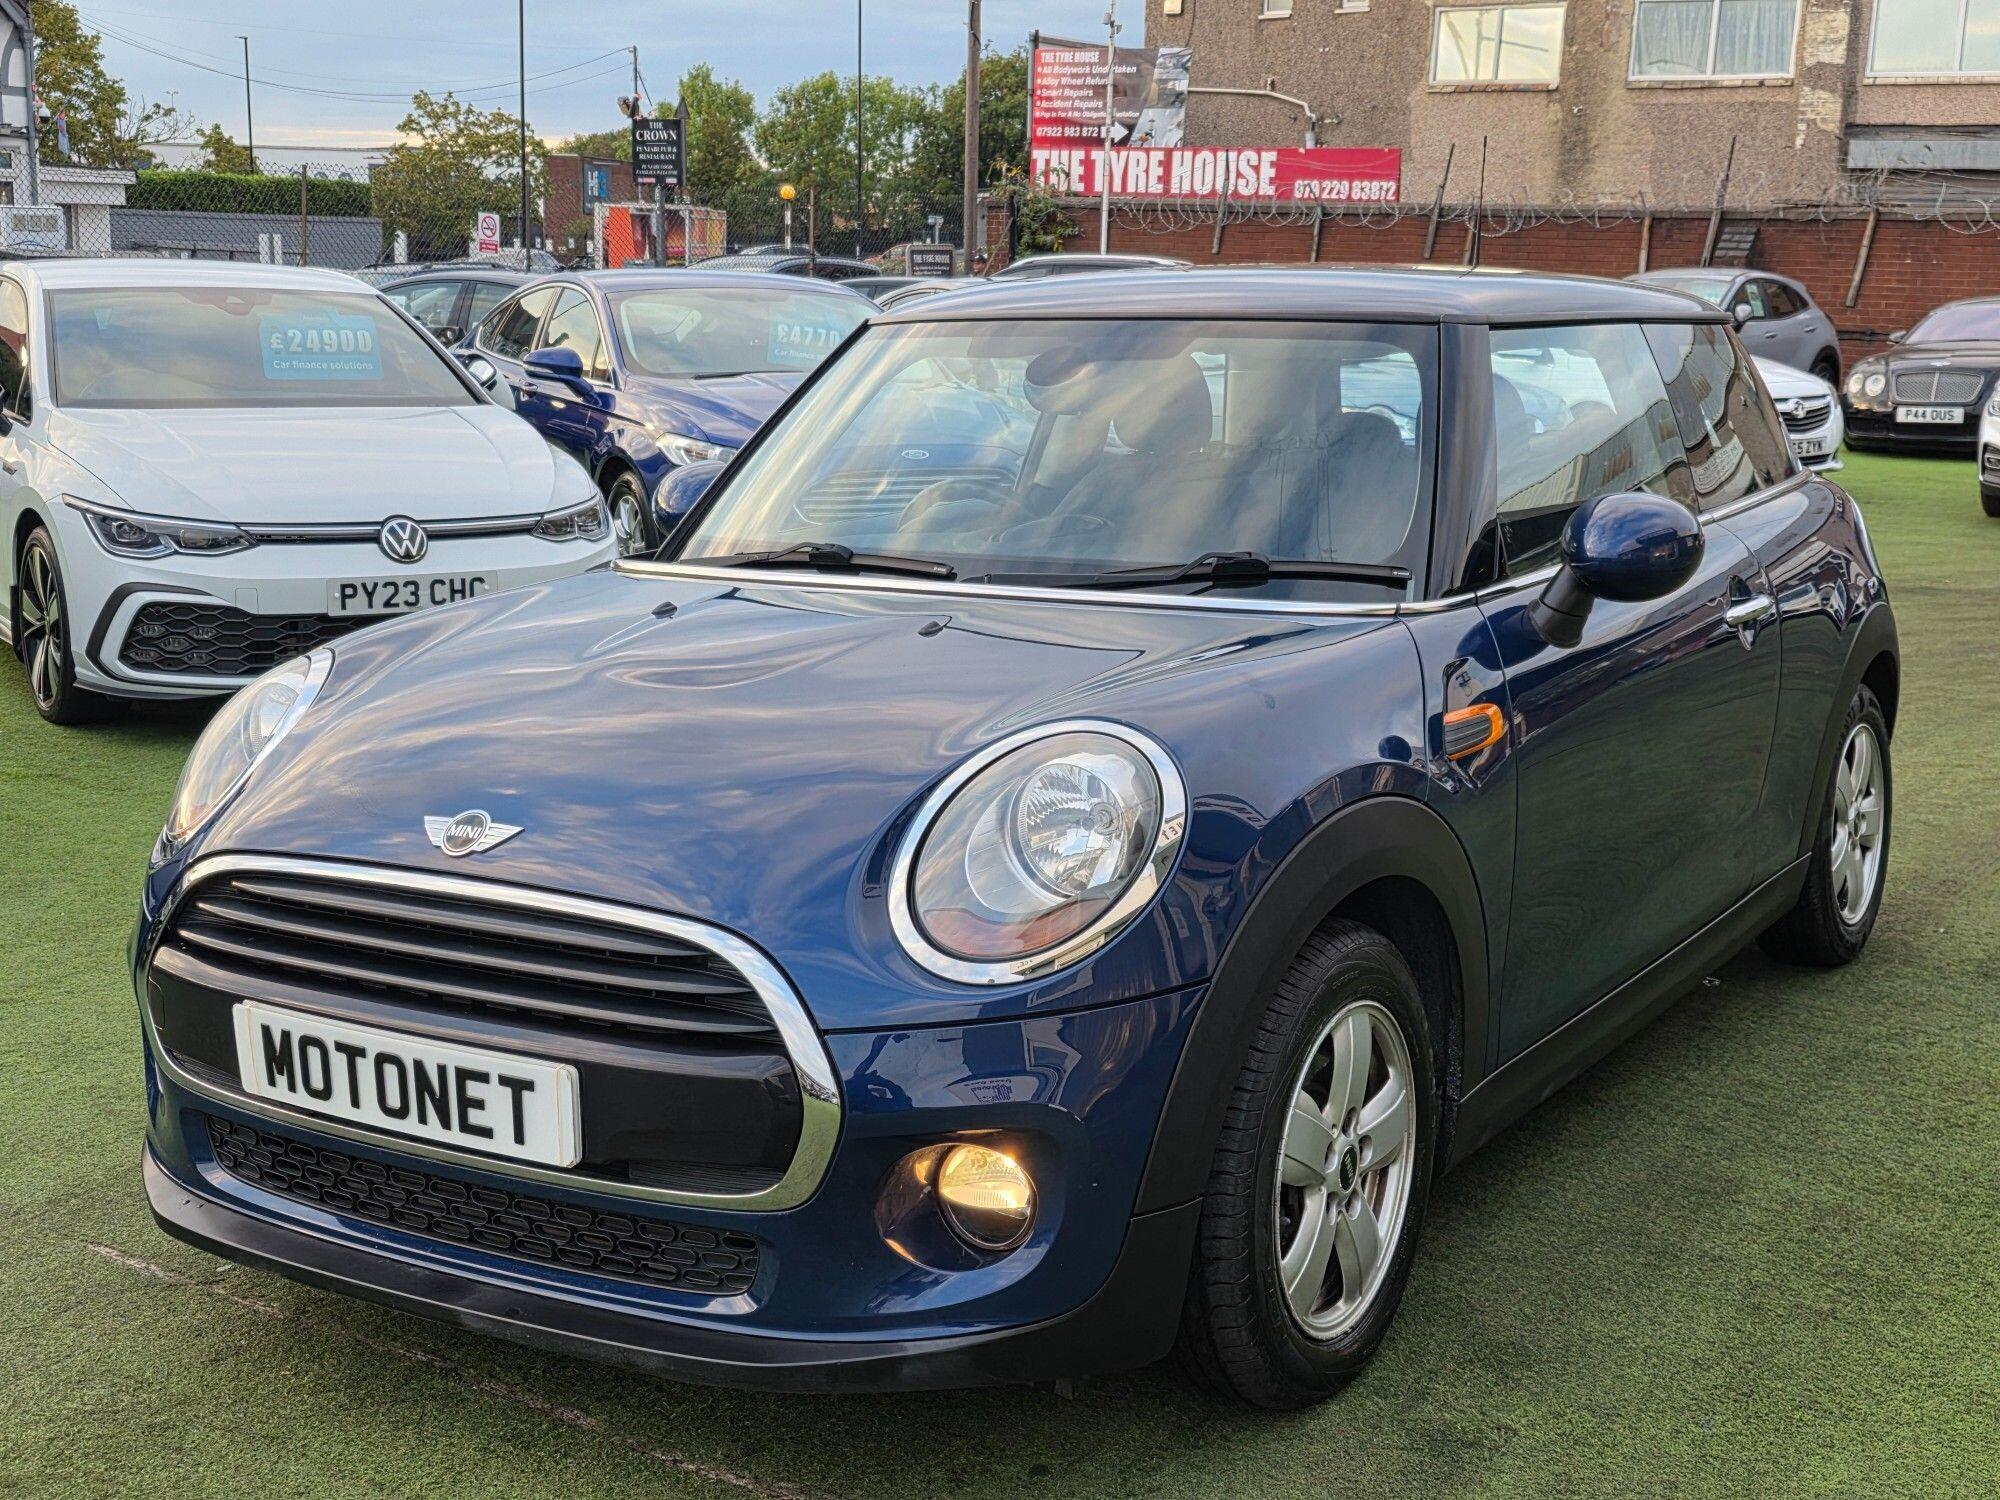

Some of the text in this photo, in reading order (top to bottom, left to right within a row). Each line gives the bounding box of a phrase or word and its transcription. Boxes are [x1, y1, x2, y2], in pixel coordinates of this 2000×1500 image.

[1041, 52, 1099, 62] THE TYRE HOUSE
[1053, 65, 1090, 76] Bodywork
[1092, 64, 1137, 74] Undrtaken
[1041, 78, 1060, 87] Alloy
[1061, 77, 1083, 85] Wheel
[1041, 89, 1094, 98] Smart Repairs
[1073, 100, 1103, 109] Repairs
[649, 121, 664, 129] THE
[635, 130, 677, 140] CROWN
[1036, 127, 1099, 137] 07922 983 872
[1032, 149, 1278, 196] THE TYRE HOUSE
[1321, 180, 1349, 199] 229
[270, 329, 373, 352] £24900
[775, 347, 788, 356] Car
[273, 359, 373, 370] Car finance solutions
[339, 579, 421, 611] PY23
[447, 824, 482, 839] MINI
[260, 1022, 535, 1146] MOTONET
